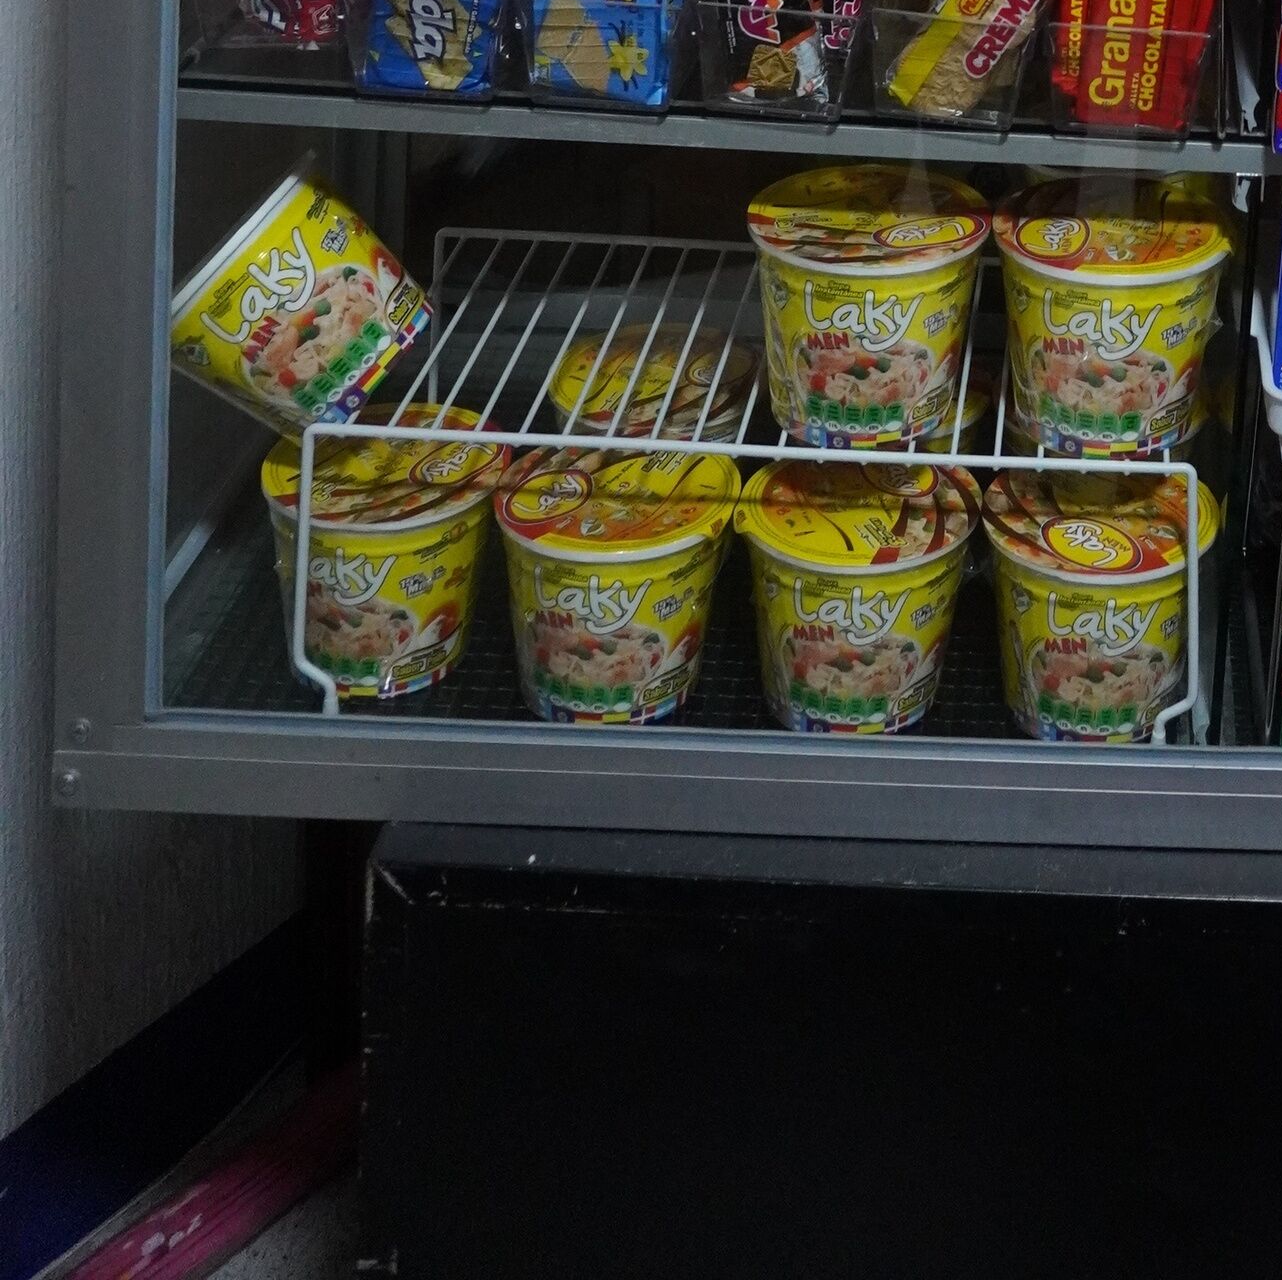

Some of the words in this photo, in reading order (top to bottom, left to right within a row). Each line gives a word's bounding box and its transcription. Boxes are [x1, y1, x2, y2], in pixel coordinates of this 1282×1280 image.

[200, 226, 317, 344] Laky
[804, 280, 924, 353] Laky
[1043, 337, 1085, 354] MEN
[793, 625, 836, 642] MEN
